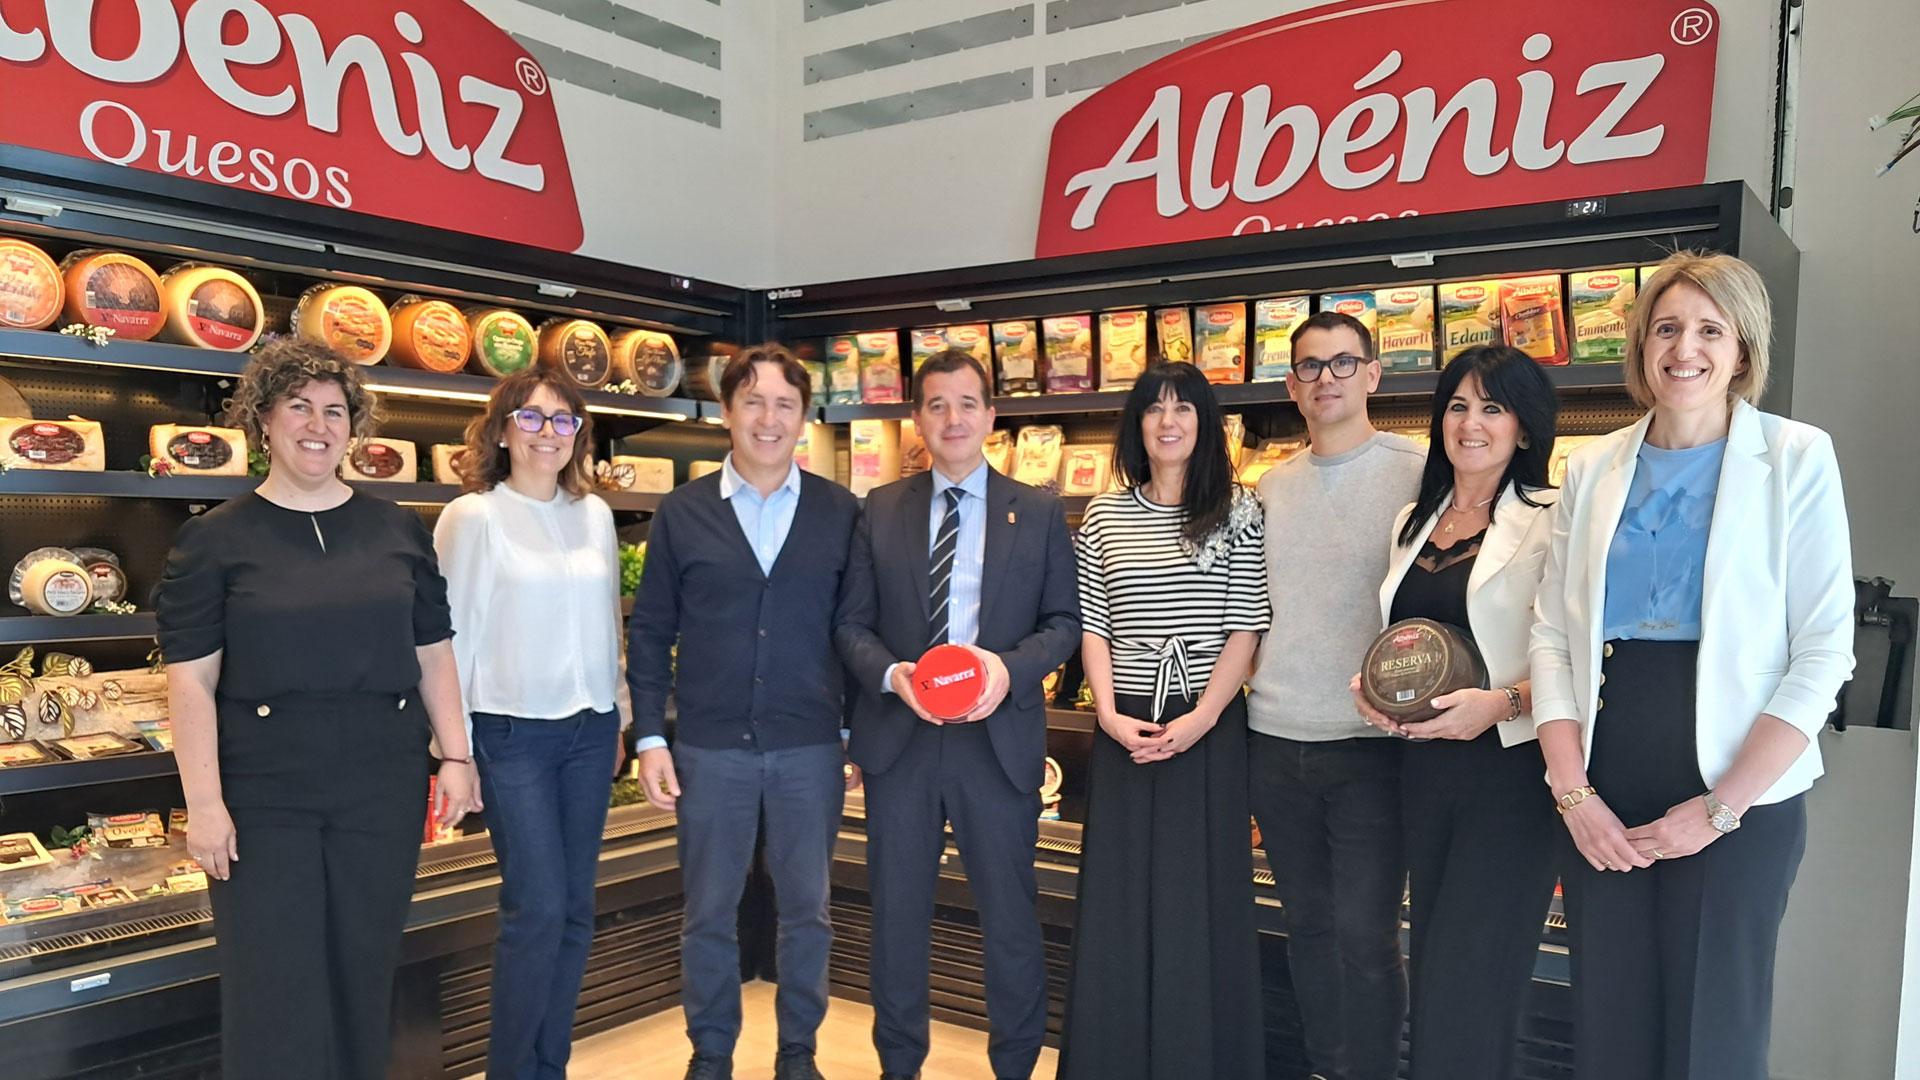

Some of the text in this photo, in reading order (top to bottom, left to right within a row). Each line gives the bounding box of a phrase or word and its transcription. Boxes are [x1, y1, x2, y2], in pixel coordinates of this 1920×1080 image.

[1065, 33, 1666, 231] Albéniz
[79, 100, 352, 208] Quesos
[113, 314, 149, 325] Navarra
[1577, 320, 1627, 337] Emmenta
[209, 327, 242, 341] Navarra
[1382, 331, 1429, 349] Havarti
[1450, 326, 1496, 346] Edam
[1381, 652, 1431, 672] RESERVA
[933, 667, 976, 688] Navarra
